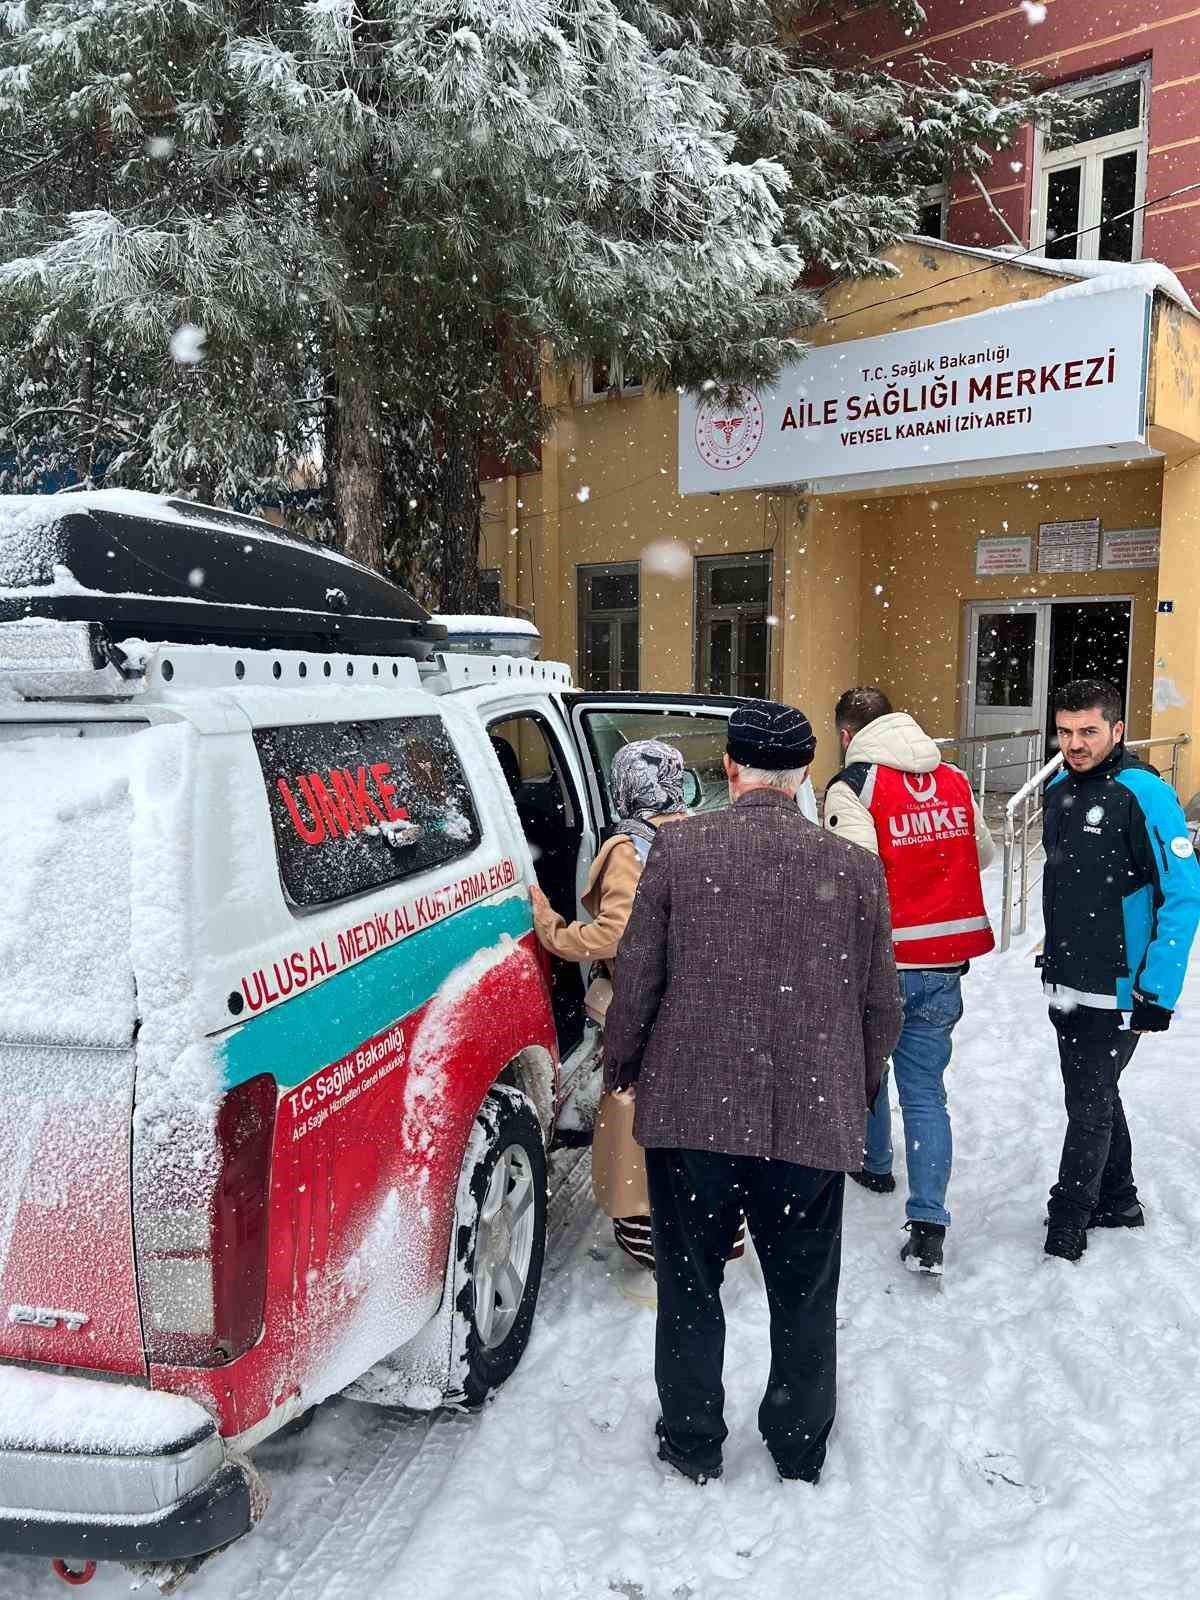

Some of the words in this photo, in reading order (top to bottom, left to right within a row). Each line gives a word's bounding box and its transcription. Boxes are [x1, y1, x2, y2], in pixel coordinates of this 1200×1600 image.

[862, 367, 888, 382] T.C.
[891, 358, 935, 378] Sağlık
[939, 345, 1010, 369] Bakanlığı
[780, 398, 839, 431] AİLE
[846, 375, 957, 421] SAĞLIĞI
[968, 347, 1115, 404] MERKEZİ
[840, 427, 892, 447] VEYSEL
[895, 415, 951, 439] KARANİ
[955, 406, 1032, 433] (ZİYARET)
[276, 762, 409, 845] UMKE
[888, 806, 969, 838] UMKE
[891, 832, 935, 848] MEDICAL
[241, 942, 337, 1011] ULUSAL
[337, 905, 415, 965] MEDİKAL
[415, 871, 489, 926] KURTARMA
[355, 1026, 405, 1074] Bakanlığı
[292, 1121, 307, 1142] Acil
[307, 1107, 329, 1131] Sağlık
[361, 1072, 379, 1092] Genel
